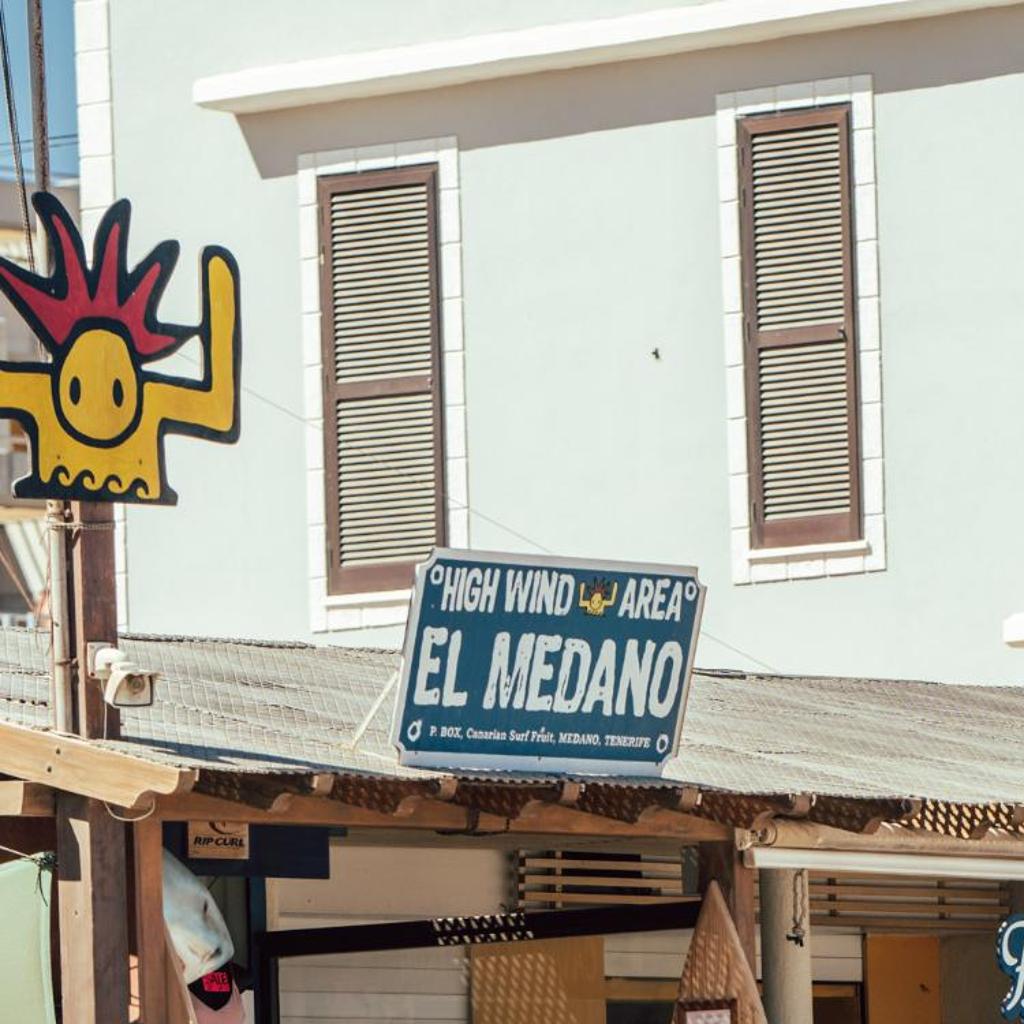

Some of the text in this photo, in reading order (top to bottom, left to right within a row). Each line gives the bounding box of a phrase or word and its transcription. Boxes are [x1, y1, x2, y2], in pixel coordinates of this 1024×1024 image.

[441, 566, 682, 622] HIGH WIND AREA
[413, 626, 683, 719] EL MEDANO
[466, 728, 507, 742] Canarian
[509, 729, 529, 742] Surf
[604, 735, 651, 748] TENERIFE
[193, 836, 245, 848] RIP CURL
